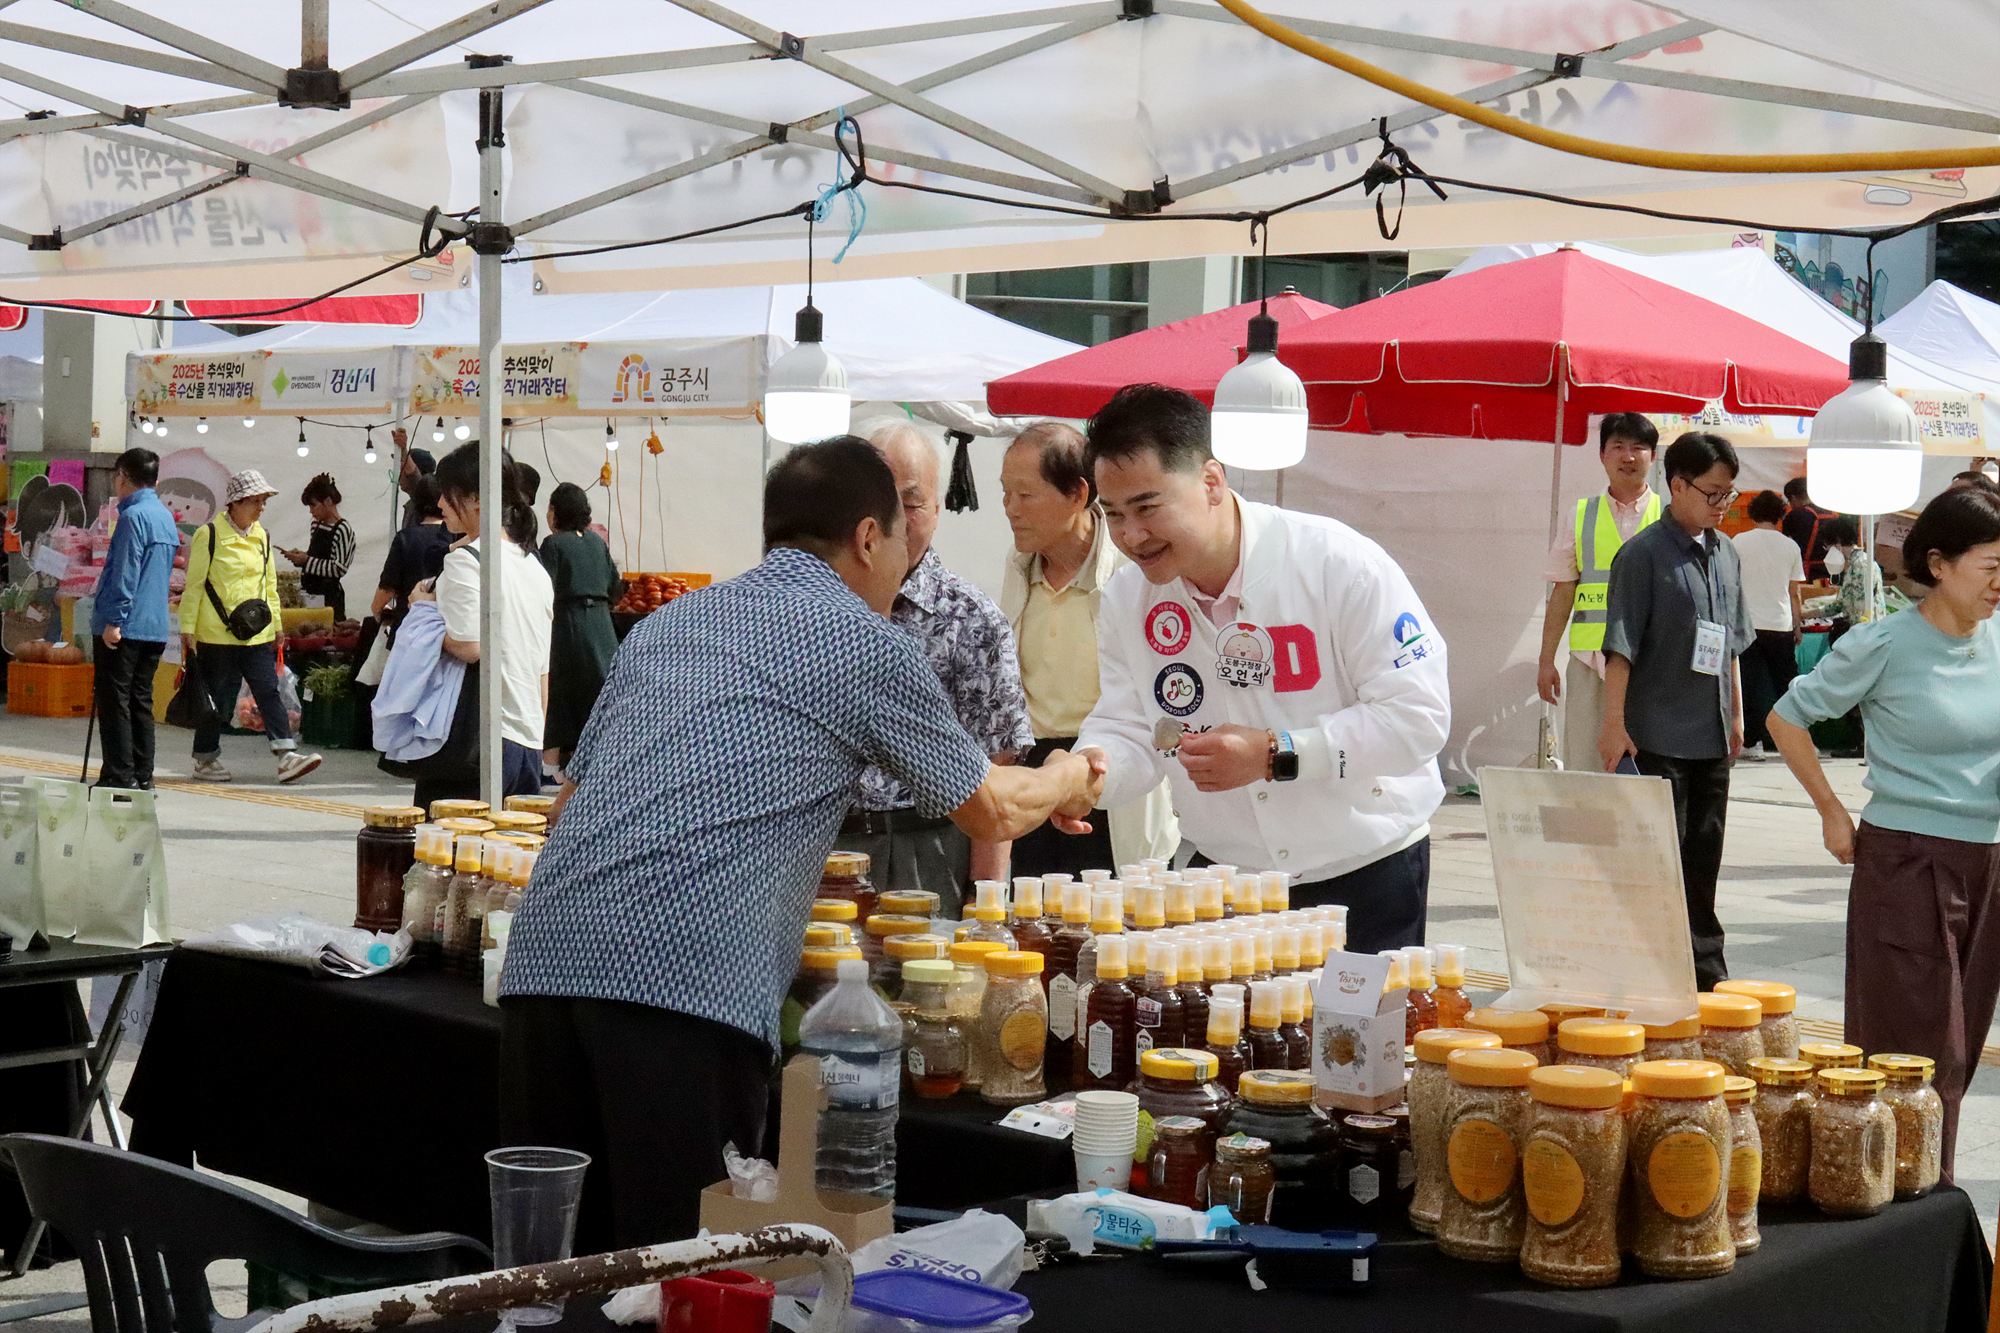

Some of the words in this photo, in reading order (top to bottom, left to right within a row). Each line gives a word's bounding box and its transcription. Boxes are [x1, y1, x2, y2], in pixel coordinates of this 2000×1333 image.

[172, 363, 206, 380] 2025년
[206, 362, 245, 380] 추석맞이
[458, 358, 480, 375] 202
[503, 355, 554, 376] 추석맞이
[443, 377, 480, 398] 농축수
[503, 377, 567, 397] 직거래장터
[660, 367, 709, 392] 공주시
[160, 381, 206, 400] 농축수산물
[207, 381, 254, 399] 직거래장터
[661, 394, 691, 403] GONGJU
[692, 393, 710, 402] CITY
[1914, 401, 1940, 417] 2025년
[1942, 401, 1969, 418] 추석맞이
[1918, 420, 1944, 437] 수산물
[1944, 420, 1979, 438] 직거래장터
[1264, 624, 1322, 693] D
[1698, 644, 1721, 655] STAFF
[1164, 665, 1185, 675] SEOUL
[1224, 657, 1262, 671] 도봉구청장
[1160, 701, 1187, 715] DOBONG
[1188, 694, 1202, 713] SOCKS
[1106, 1213, 1143, 1236] 물티슈
